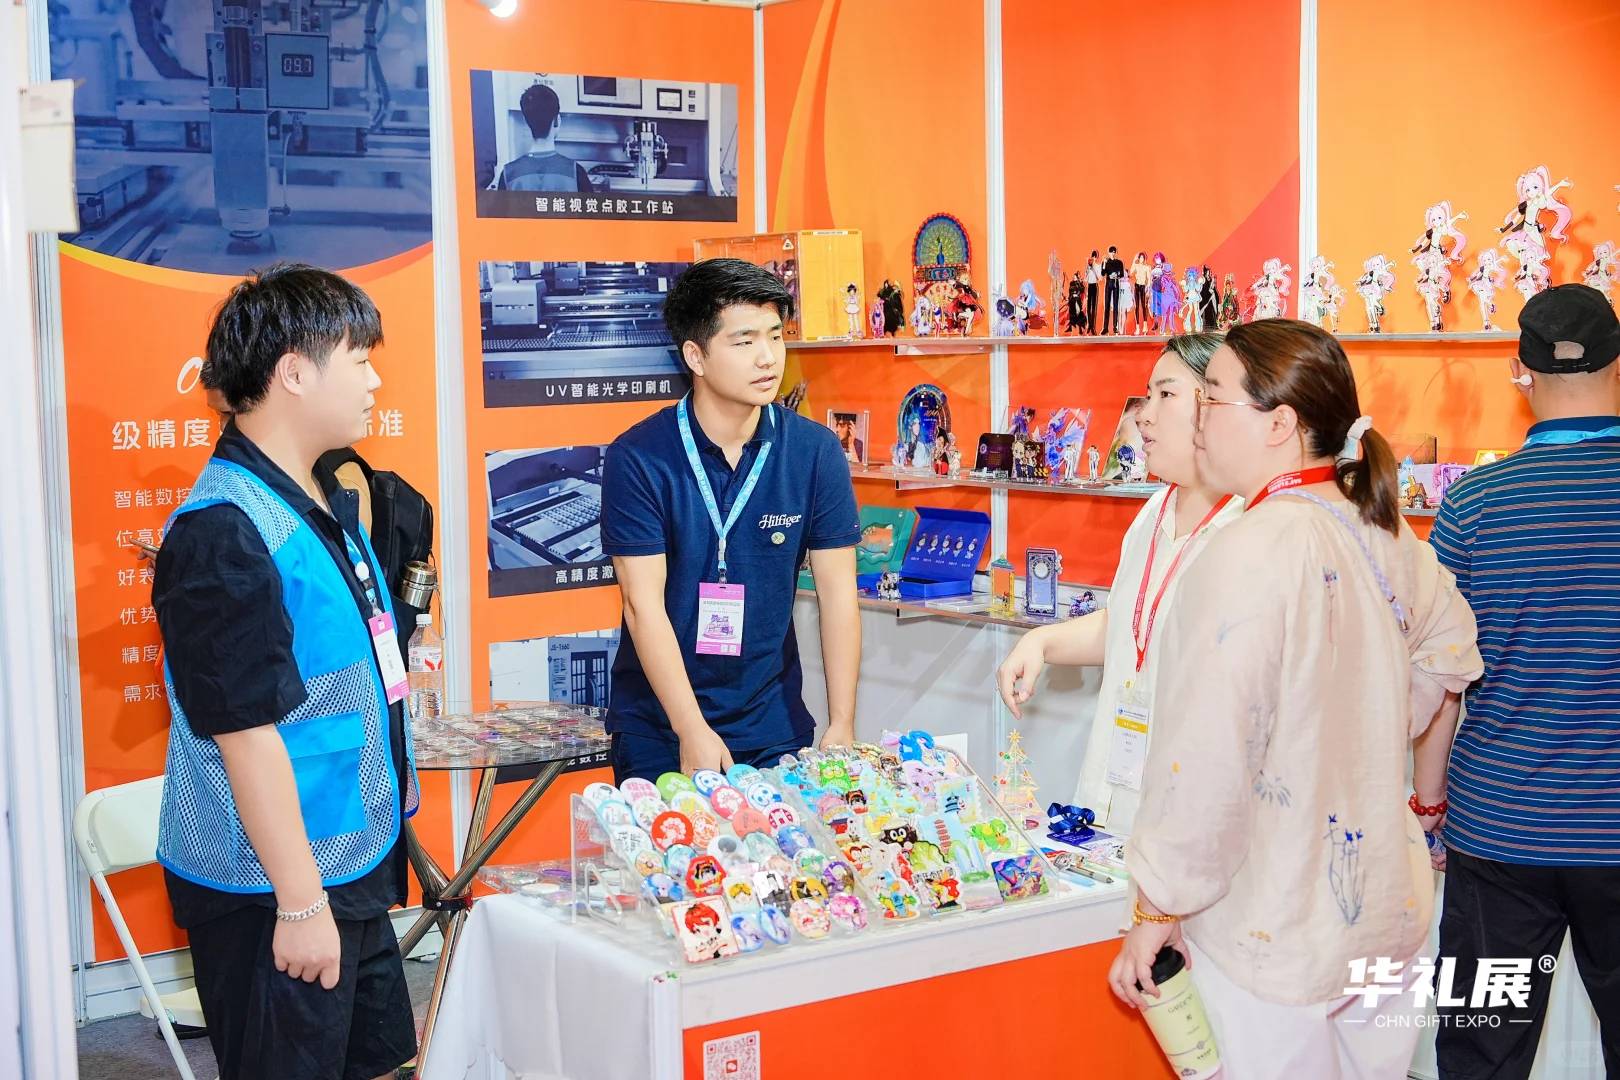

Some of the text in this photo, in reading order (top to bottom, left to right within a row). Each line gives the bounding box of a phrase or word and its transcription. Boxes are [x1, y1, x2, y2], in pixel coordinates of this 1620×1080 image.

[535, 197, 674, 214] 智能视觉点胶工作站
[545, 380, 671, 398] UV智能光学印刷机
[758, 513, 802, 530] Hilfiger
[120, 605, 157, 625] 优势
[122, 644, 159, 664] 精度
[124, 682, 162, 703] 需求
